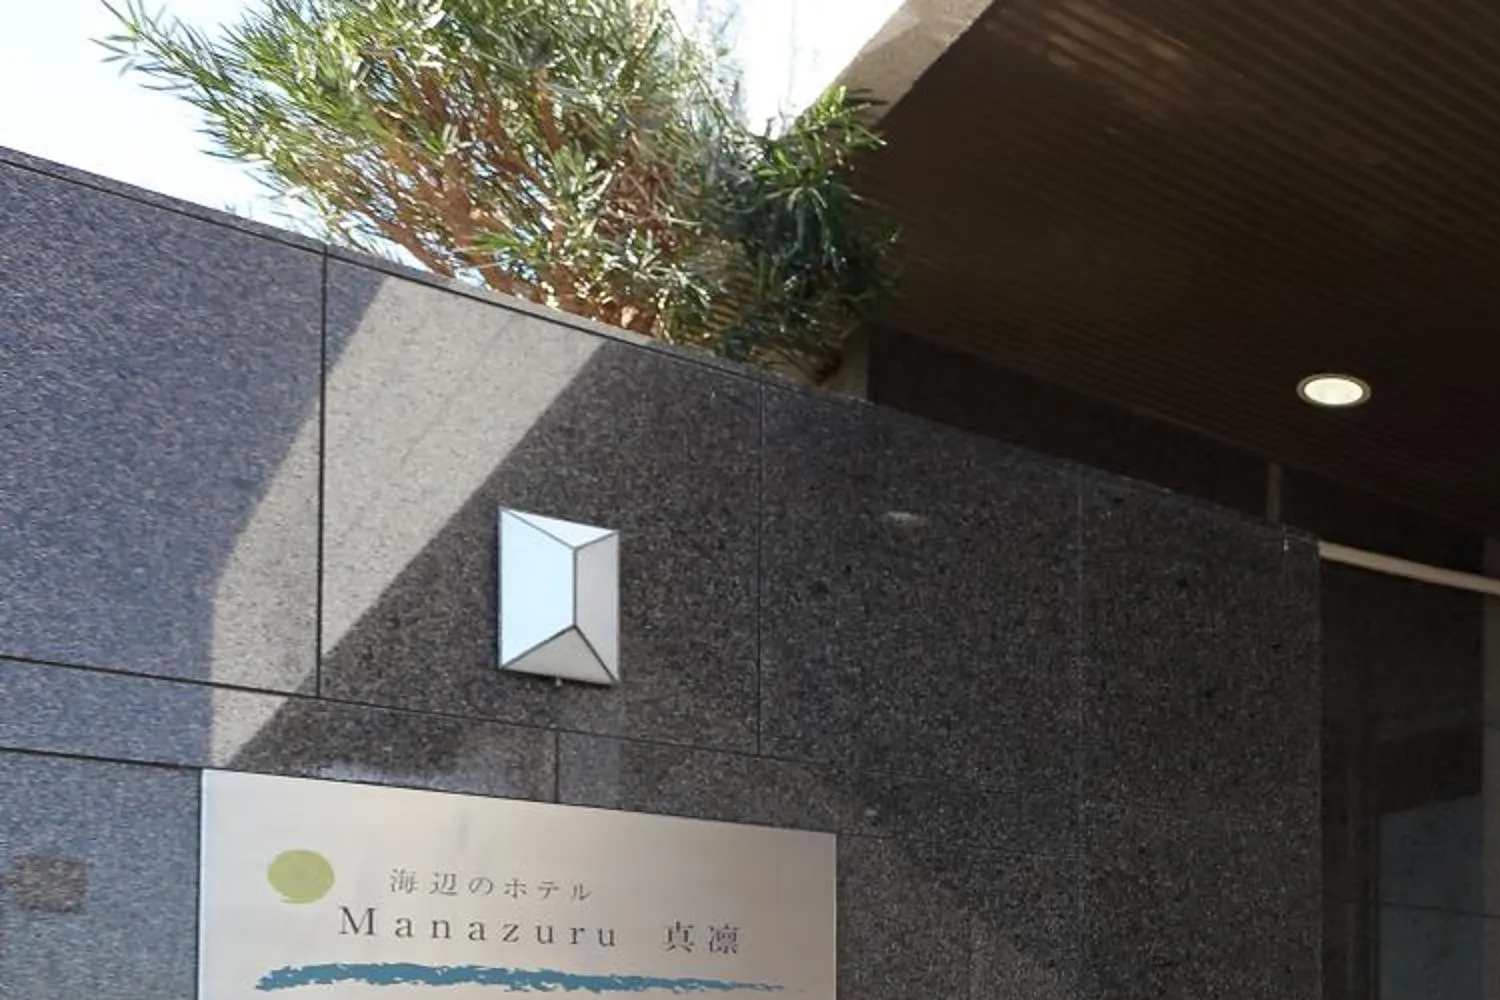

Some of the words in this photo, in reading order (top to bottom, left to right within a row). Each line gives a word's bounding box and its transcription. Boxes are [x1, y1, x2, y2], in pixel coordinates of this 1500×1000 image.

[389, 868, 593, 901] 海辺のホテル
[338, 905, 618, 948] Manazuru
